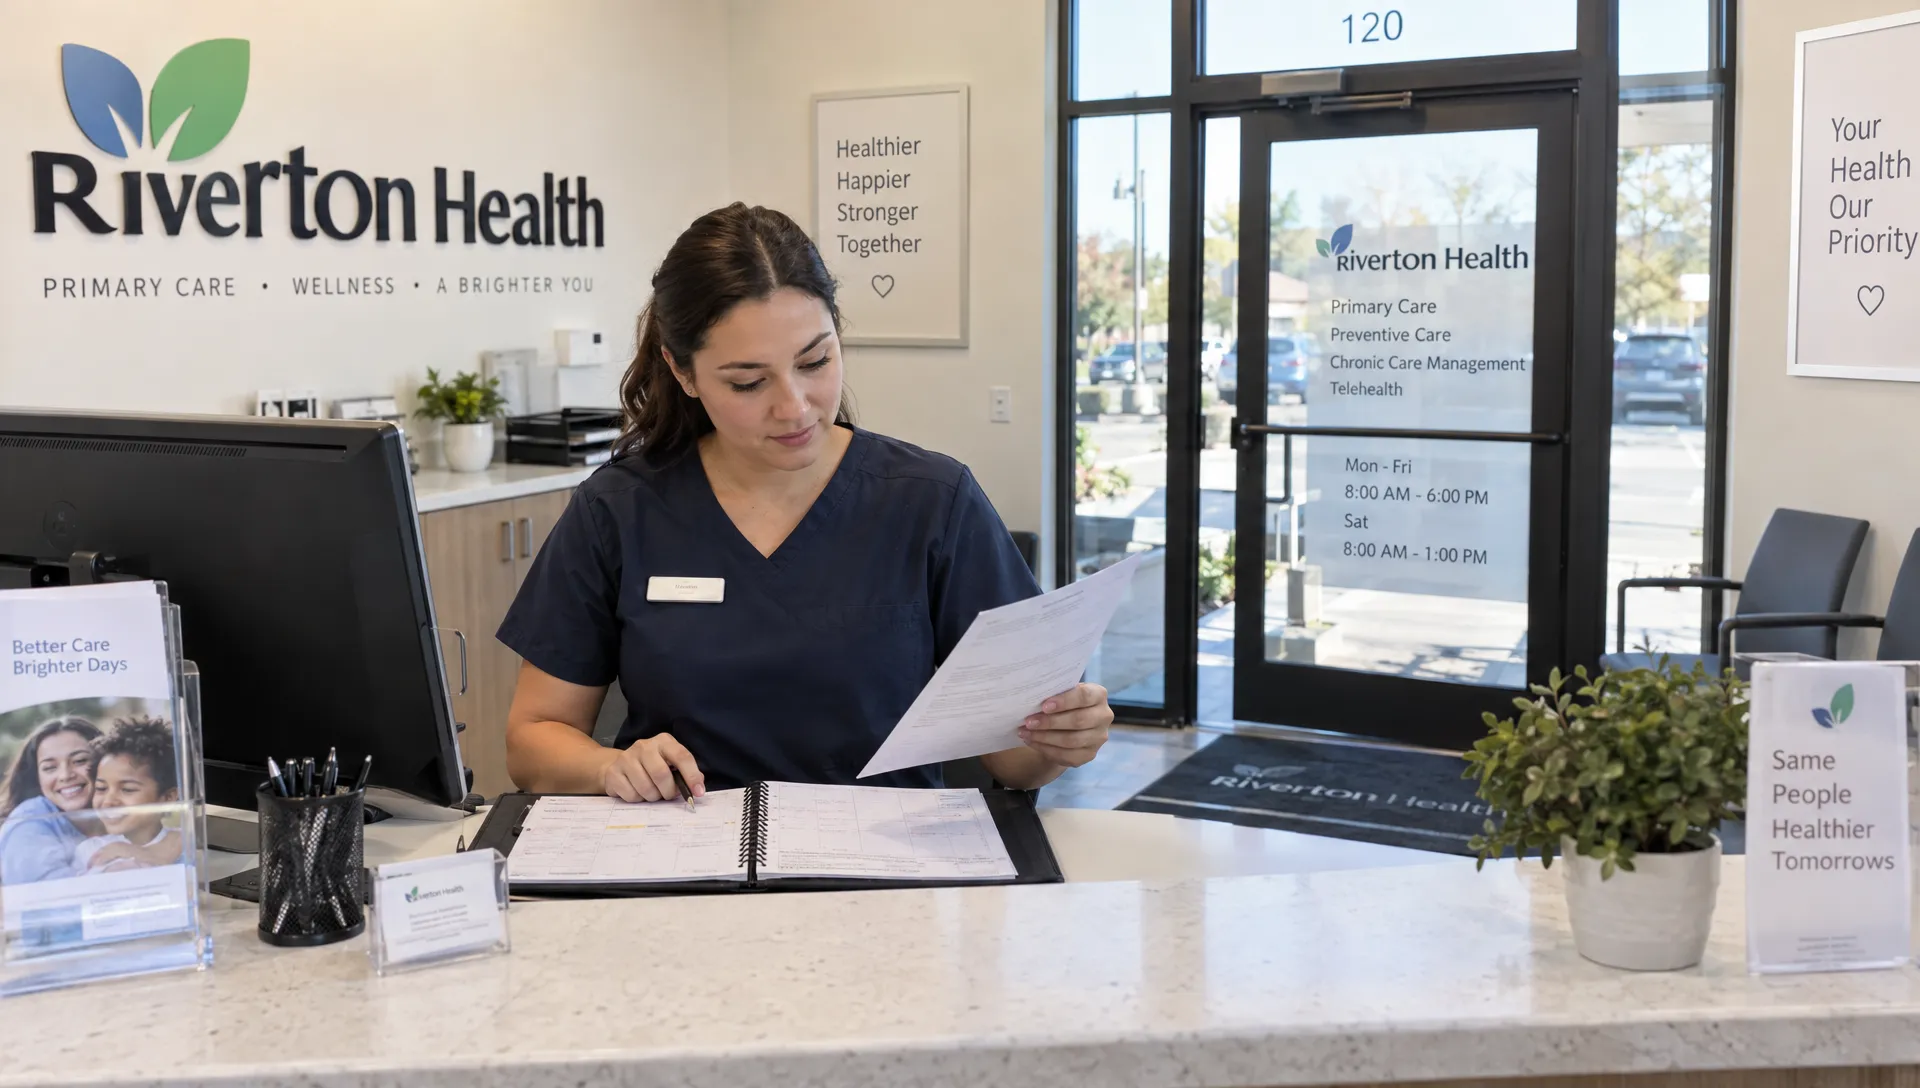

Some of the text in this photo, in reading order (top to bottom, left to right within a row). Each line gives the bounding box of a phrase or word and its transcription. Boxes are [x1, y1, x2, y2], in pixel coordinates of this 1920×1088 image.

[1342, 9, 1404, 44] 120
[1831, 117, 1882, 143] Your
[837, 136, 922, 159] Healthier
[1830, 149, 1911, 183] Health
[837, 169, 911, 195] Happier
[31, 146, 605, 248] Riverton Health
[1829, 194, 1873, 220] Our
[837, 202, 919, 226] Stronger
[837, 233, 922, 259] Together
[1828, 225, 1919, 260] Priority
[1336, 244, 1529, 272] Riverton Health
[43, 276, 594, 299] PRIMARY CARE WELLNESS A BRIGHTER YOU
[1331, 298, 1437, 317] Primary Care
[1330, 327, 1452, 342] Preventive Care
[1330, 355, 1526, 374] Chronic Care Management
[1330, 381, 1403, 396] Telehealth
[1345, 457, 1378, 473] Mon
[1393, 459, 1412, 474] Fri
[1345, 484, 1379, 500] 8:00
[1383, 486, 1411, 501] AM
[1426, 488, 1460, 504] 6:00
[1465, 489, 1489, 505] PM
[1344, 513, 1369, 529] Sat
[1343, 541, 1376, 557] 8:00
[1380, 544, 1408, 560] AM
[1425, 546, 1458, 563] 1:00
[1463, 549, 1487, 565] PM
[12, 637, 111, 655] Better Care
[13, 657, 128, 678] Brighter Days
[1772, 749, 1836, 770] Same
[1210, 774, 1378, 803] Riverton
[1772, 783, 1852, 809] People
[1772, 818, 1876, 840] Healthier
[1771, 850, 1895, 871] Tomorrows
